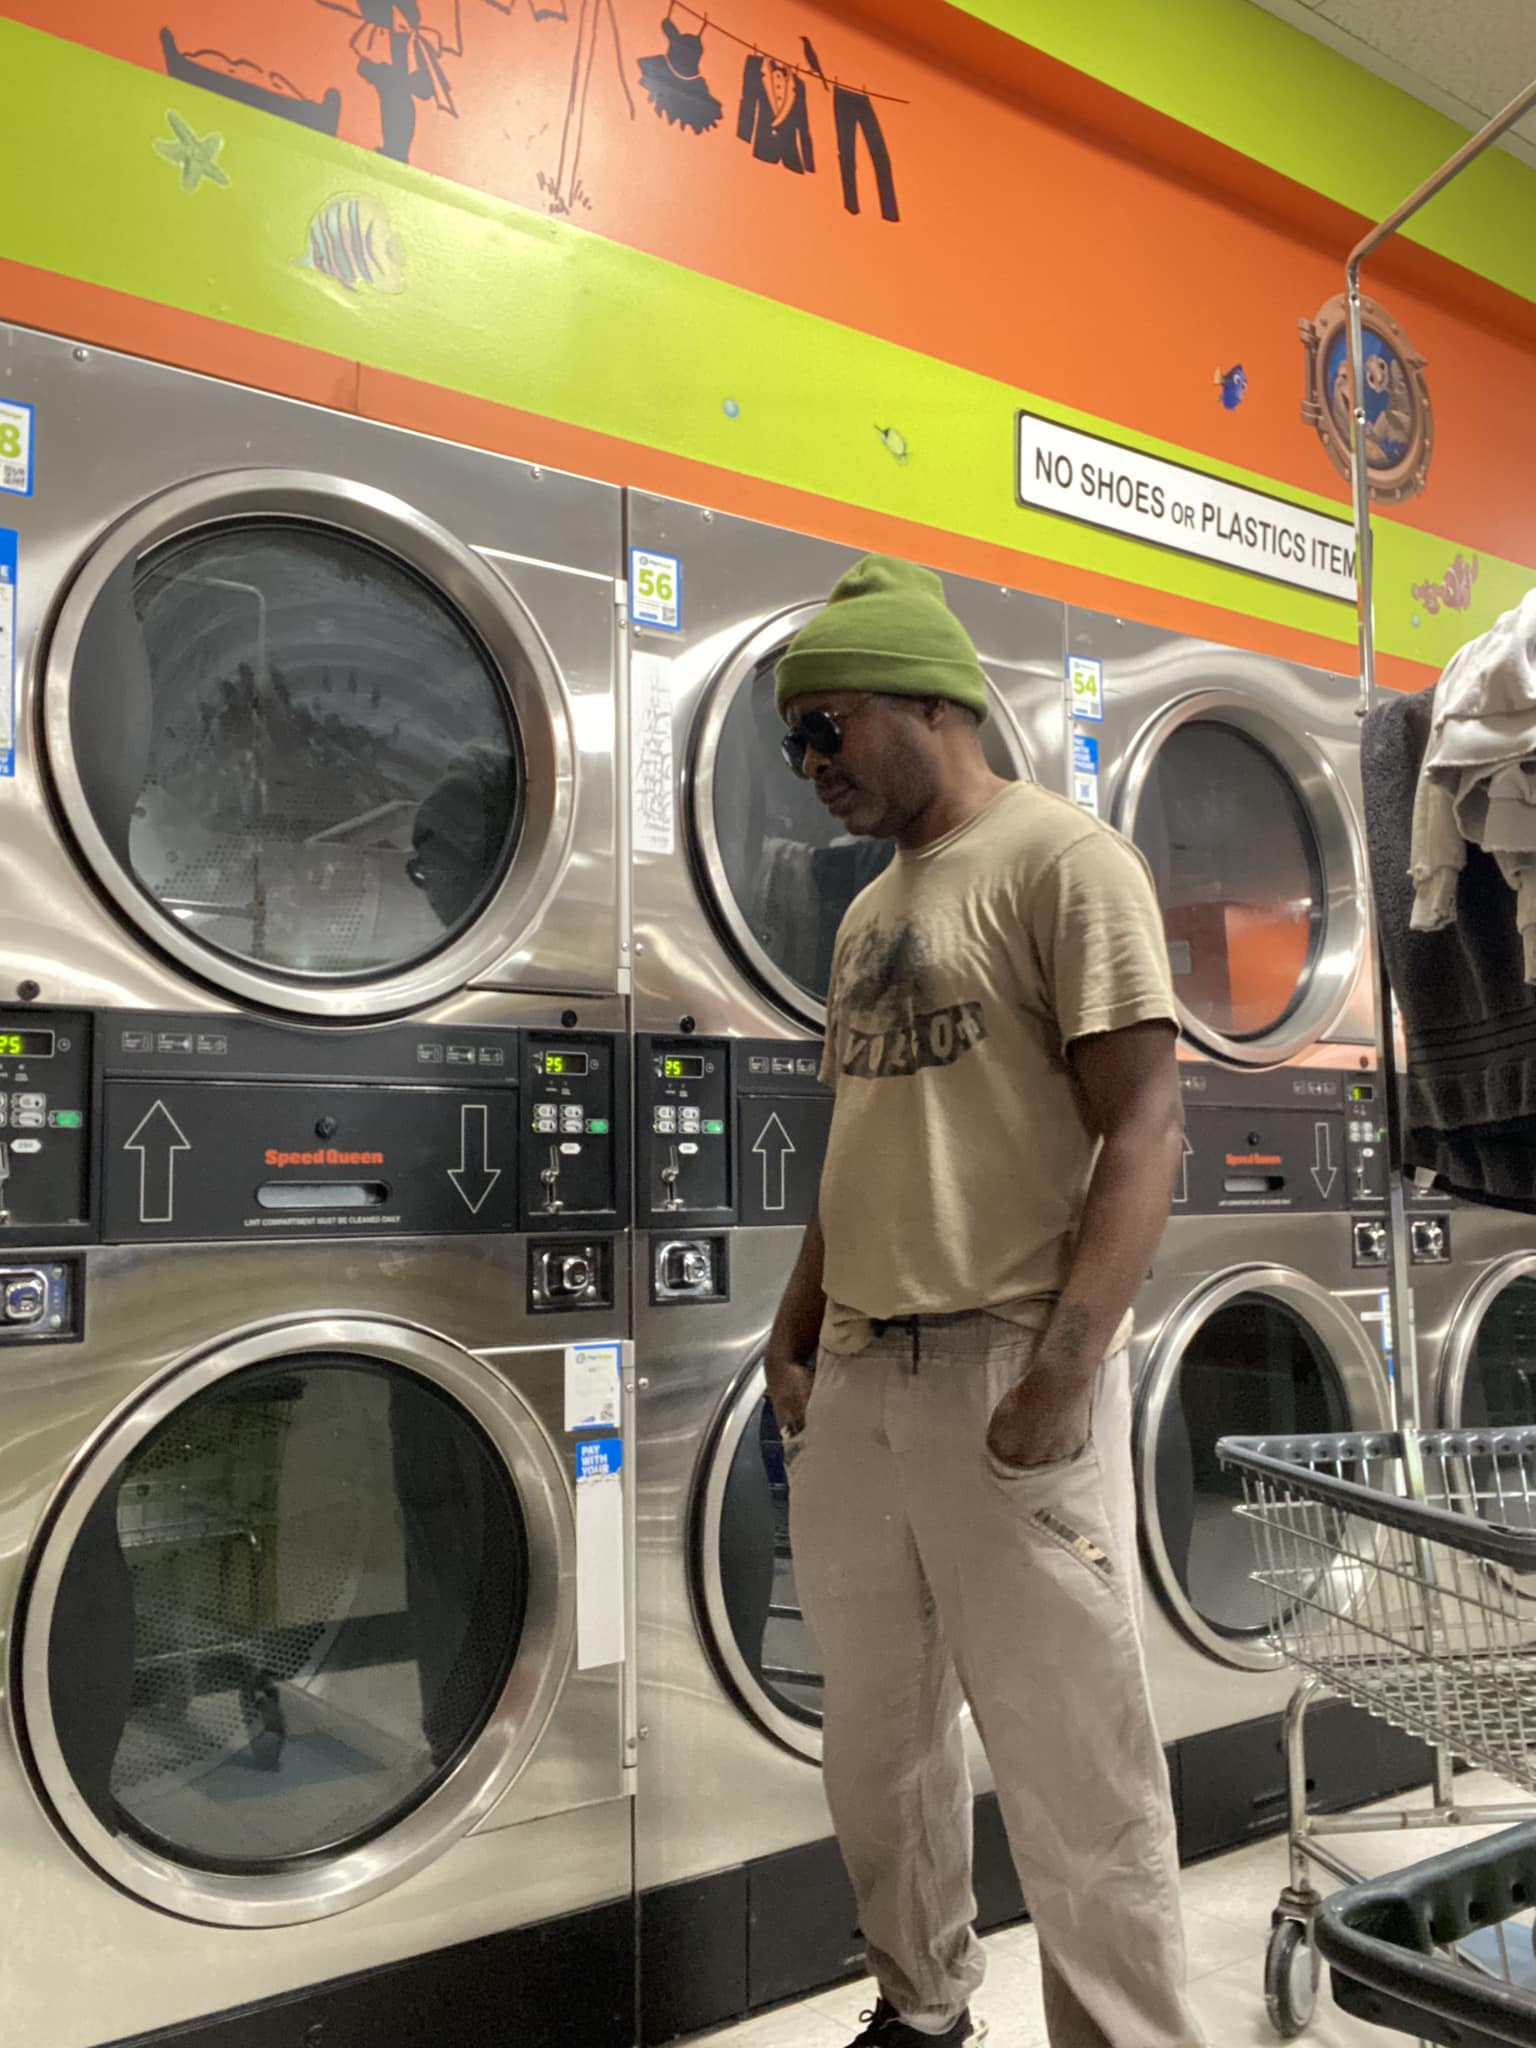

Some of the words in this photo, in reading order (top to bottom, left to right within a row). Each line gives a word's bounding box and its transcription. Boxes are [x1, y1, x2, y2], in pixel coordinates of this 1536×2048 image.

[1035, 446, 1073, 489] NO
[1080, 463, 1165, 519] SHOES
[1171, 502, 1195, 529] OR
[1202, 502, 1306, 563] PLASTICS
[638, 568, 673, 601] 56
[1073, 671, 1098, 698] 54
[264, 1148, 325, 1168] Speed
[326, 1149, 384, 1164] Queen
[581, 1445, 600, 1456] PAY
[581, 1454, 608, 1467] WITH
